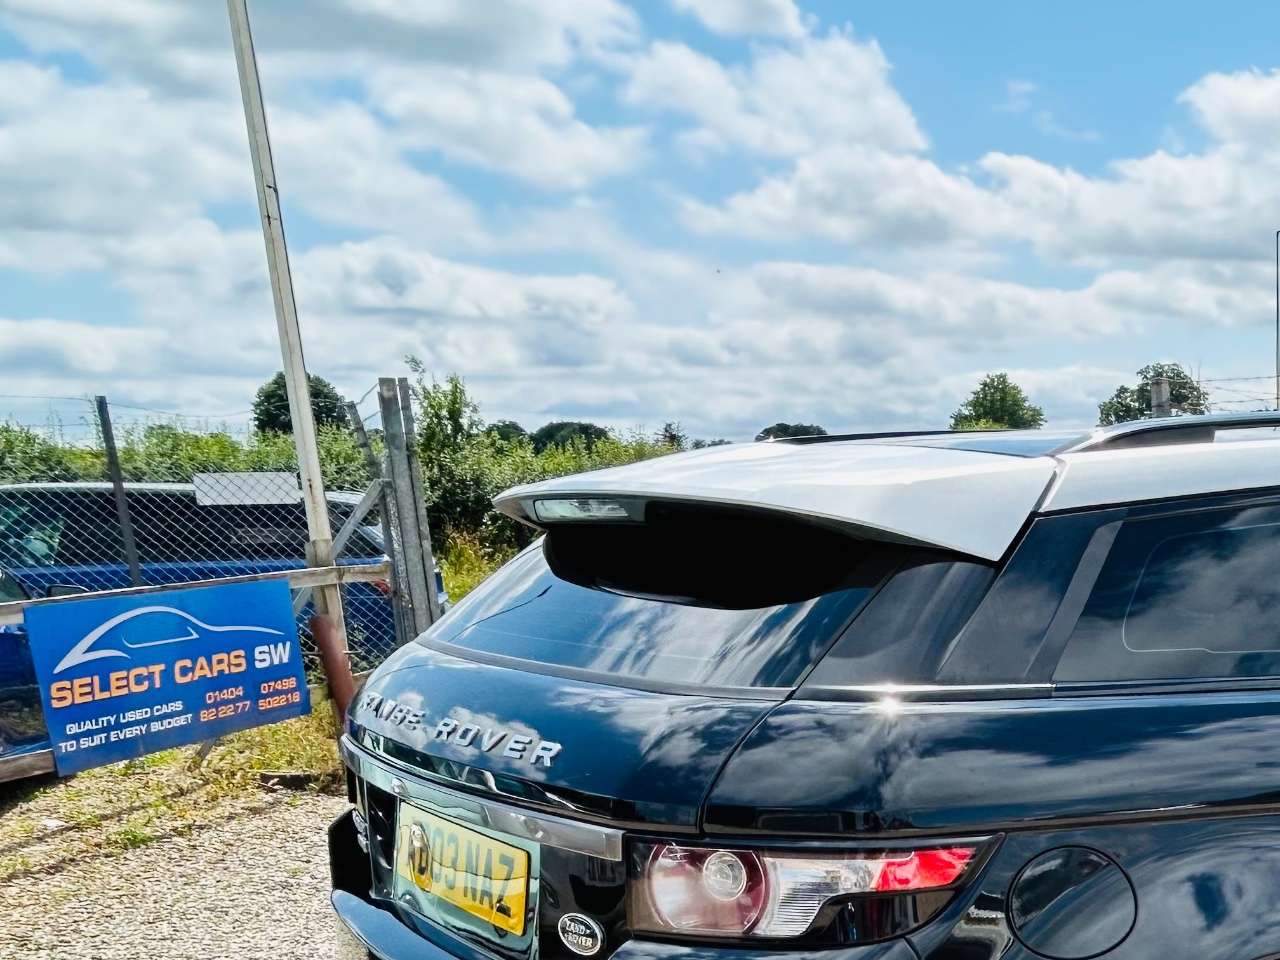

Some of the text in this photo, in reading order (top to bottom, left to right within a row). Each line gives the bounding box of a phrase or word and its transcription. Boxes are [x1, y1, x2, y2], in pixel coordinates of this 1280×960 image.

[51, 641, 292, 709] SELECT CARS SW
[206, 686, 244, 704] 01404
[59, 713, 193, 752] TO SUIT EVERY BUDGET
[66, 701, 183, 735] QUALITY USED CARS
[359, 692, 563, 767] RANGE ROVER
